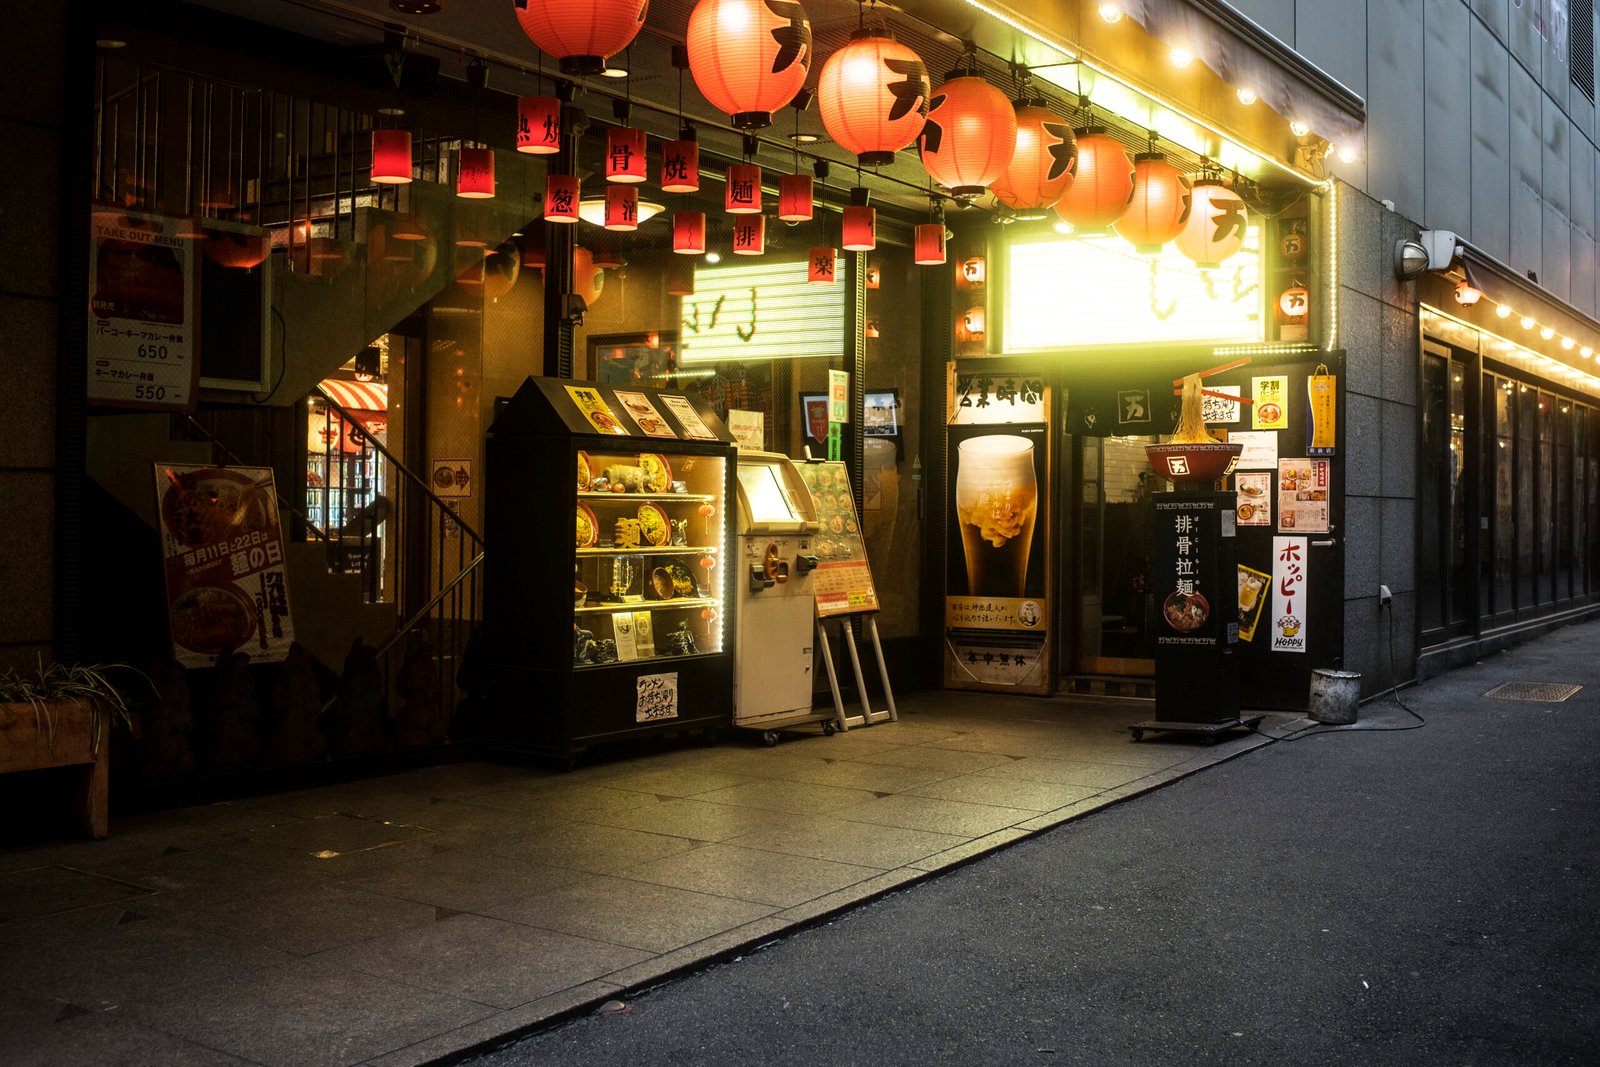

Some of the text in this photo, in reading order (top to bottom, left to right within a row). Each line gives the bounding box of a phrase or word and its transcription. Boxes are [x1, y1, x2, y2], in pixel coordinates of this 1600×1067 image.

[609, 143, 634, 172] 骨
[663, 154, 688, 181] 焼
[96, 225, 127, 240] TAKE
[129, 231, 152, 243] OUT
[153, 235, 185, 248] MENU
[736, 225, 756, 247] 排
[814, 255, 834, 276] 楽
[1288, 292, 1304, 309] 万
[137, 343, 168, 360] 650
[134, 385, 166, 401] 550
[957, 376, 1044, 409] 営業時間
[229, 539, 283, 577] 麺の日
[1174, 514, 1195, 598] 排骨拉麺
[1279, 539, 1303, 615] ホッピー
[1274, 637, 1304, 647] HOPPY
[967, 650, 1027, 667] 年中無休
